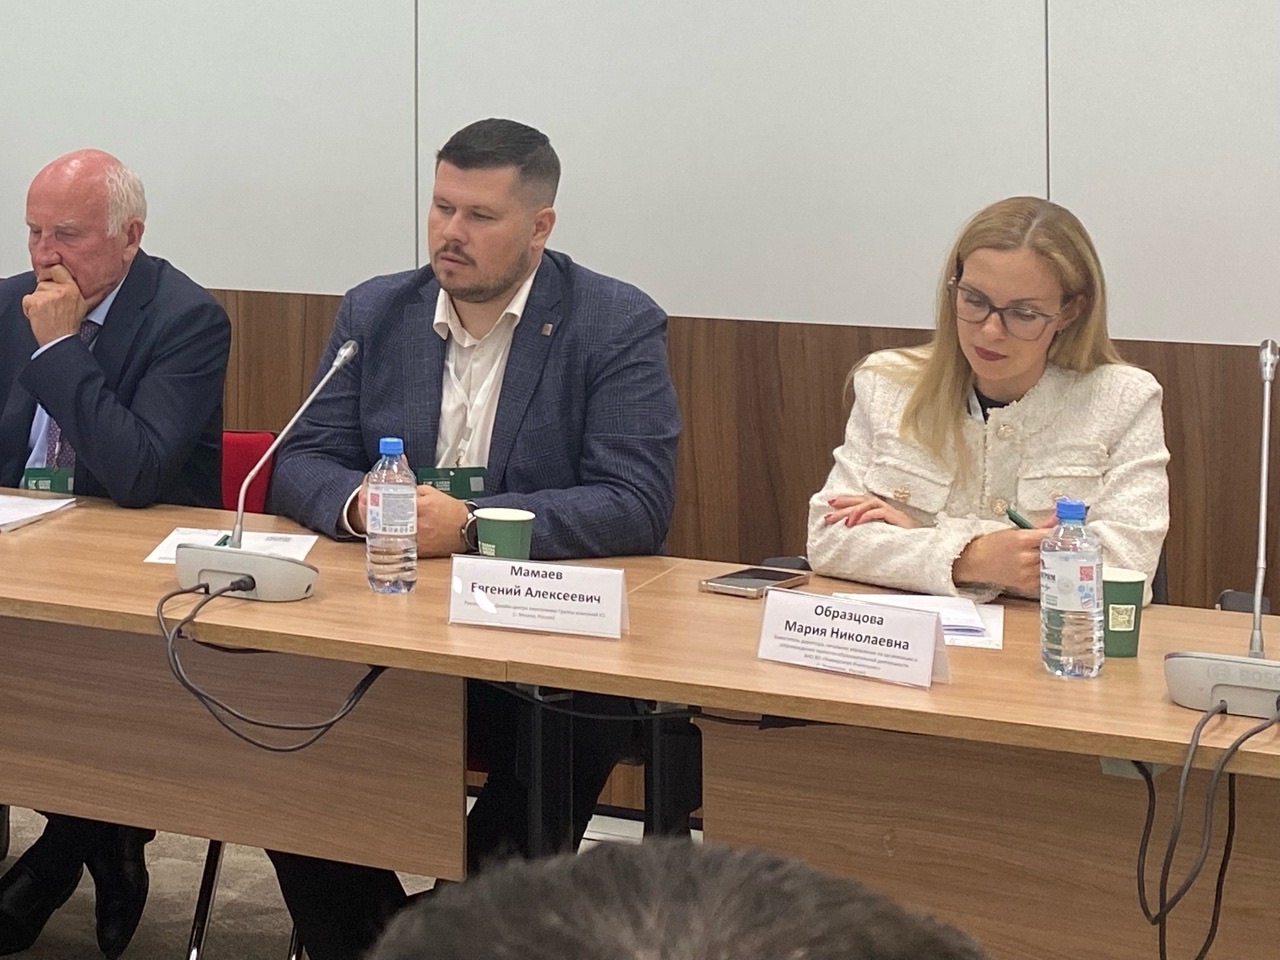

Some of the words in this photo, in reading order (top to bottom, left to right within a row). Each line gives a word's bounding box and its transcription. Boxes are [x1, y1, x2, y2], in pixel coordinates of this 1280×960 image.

[510, 566, 563, 580] Мамаев
[525, 587, 601, 604] Алексеевич
[814, 605, 884, 626] Образцова
[784, 620, 827, 637] Мария
[830, 627, 910, 650] Николаевна
